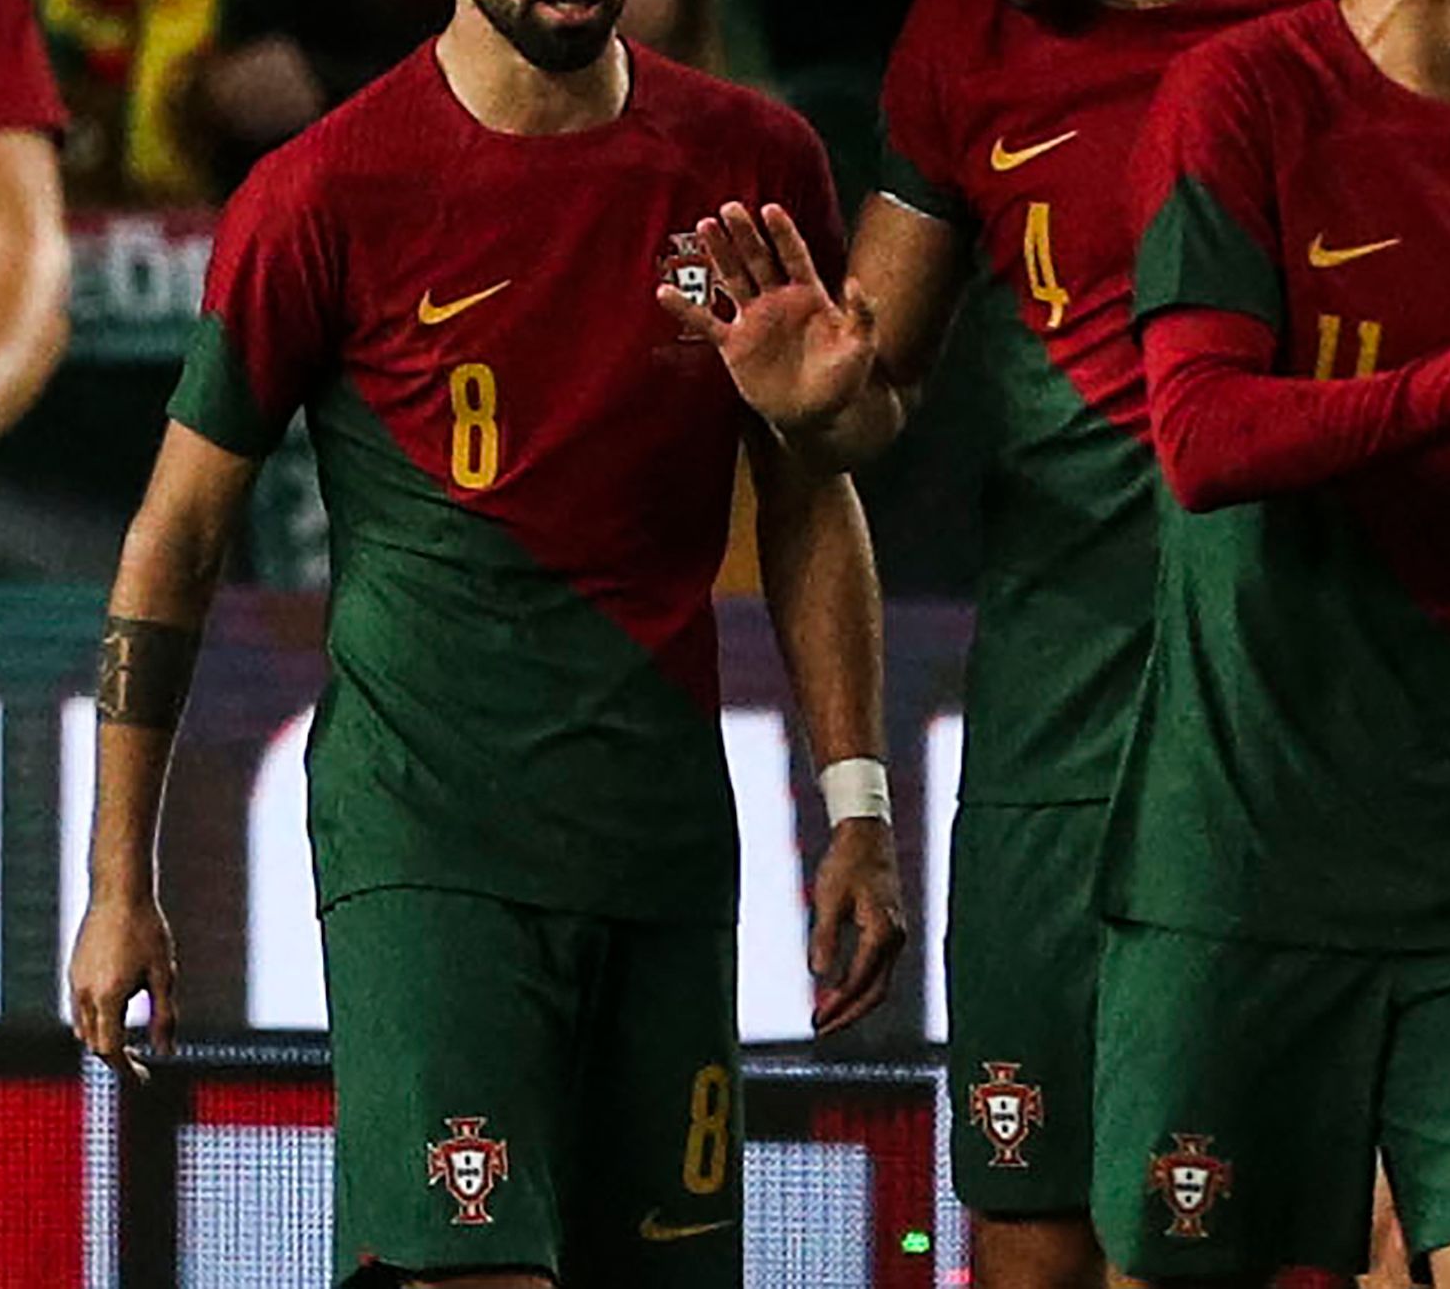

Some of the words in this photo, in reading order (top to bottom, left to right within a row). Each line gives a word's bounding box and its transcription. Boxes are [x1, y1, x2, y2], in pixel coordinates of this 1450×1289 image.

[1023, 200, 1070, 329] 4
[447, 361, 500, 491] 8
[682, 1062, 731, 1196] 8
